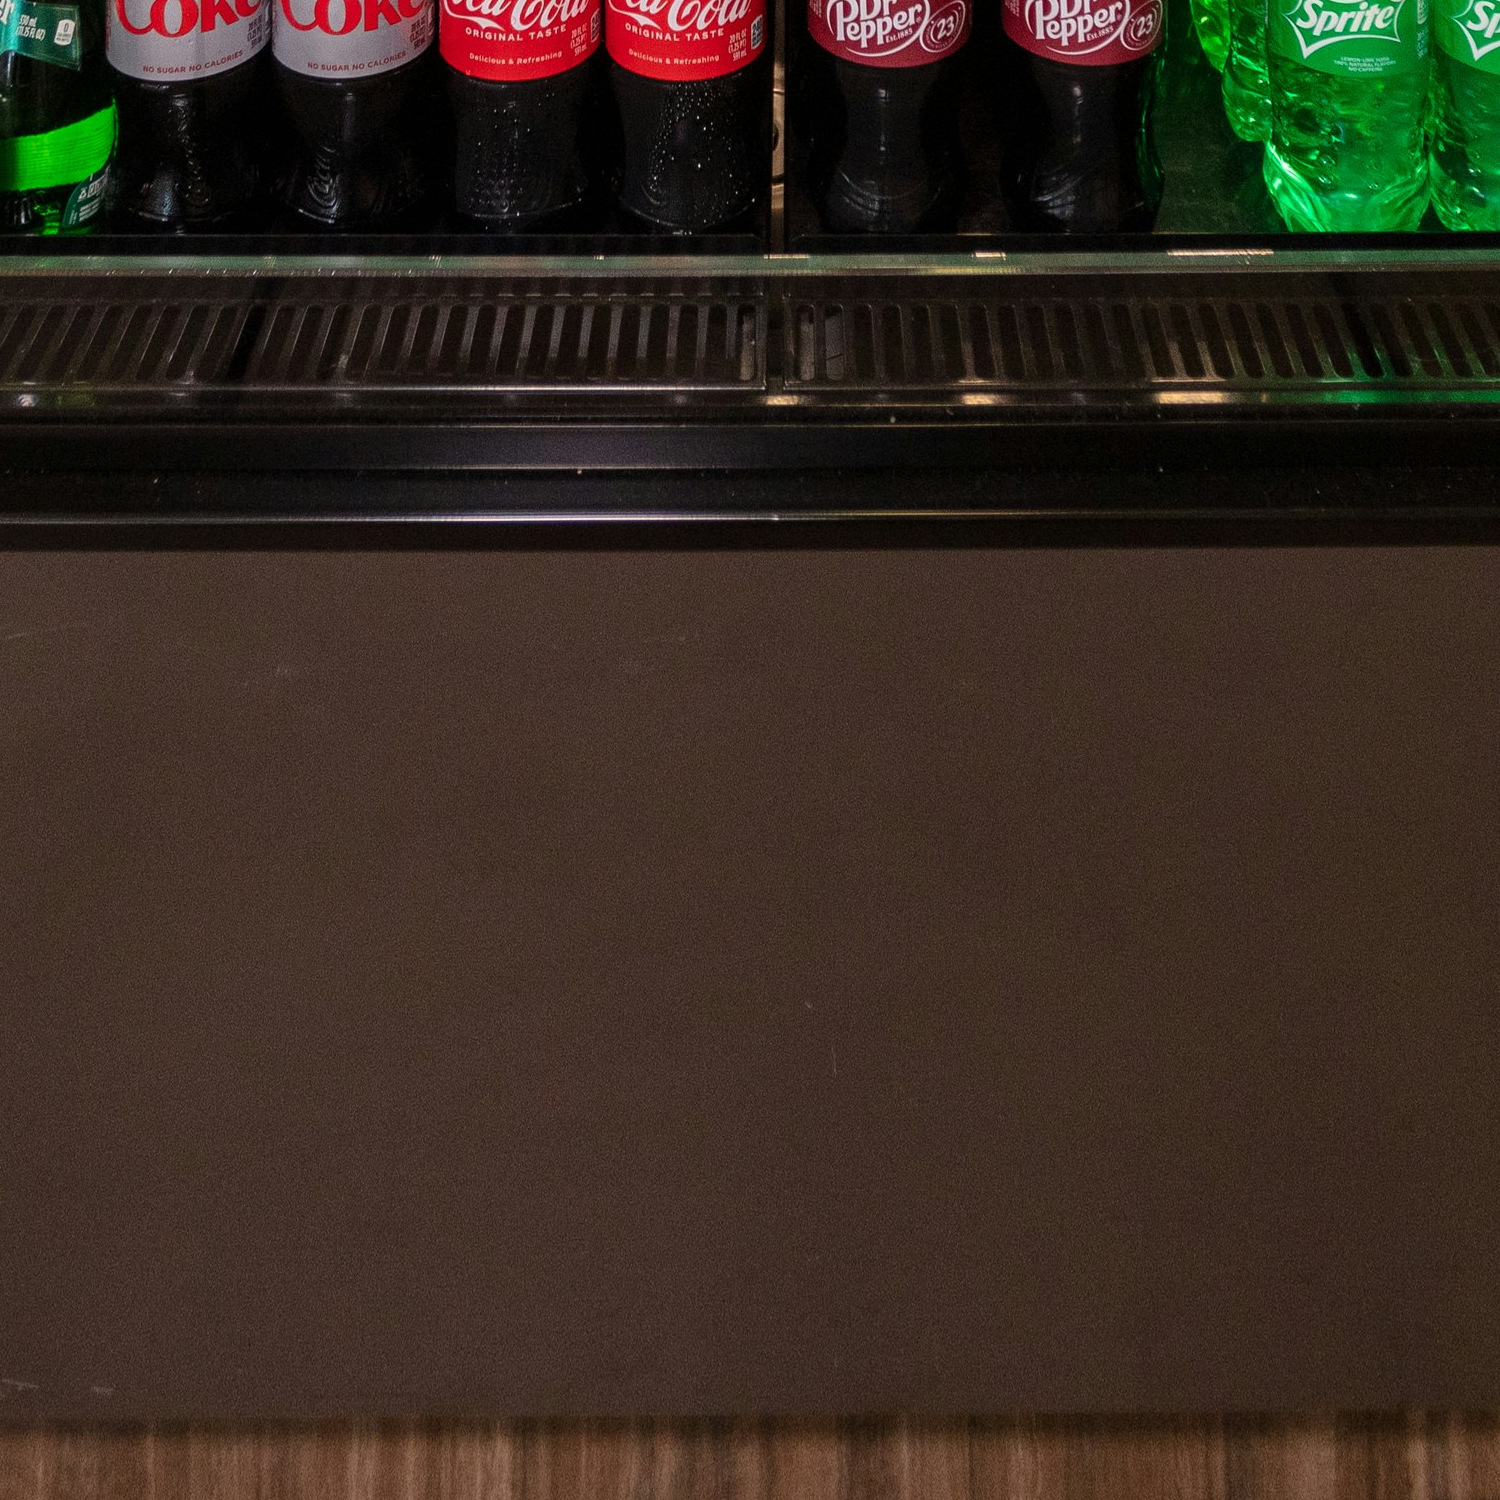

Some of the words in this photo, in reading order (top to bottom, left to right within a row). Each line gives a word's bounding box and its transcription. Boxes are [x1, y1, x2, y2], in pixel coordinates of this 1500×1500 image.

[465, 26, 524, 42] ORIGINAL
[529, 23, 567, 40] TASTE
[625, 22, 681, 42] ORIGINAL
[685, 28, 725, 41] TASTE
[936, 16, 955, 41] 23
[1136, 13, 1154, 38] 23
[156, 65, 186, 74] SUGAR
[189, 64, 202, 72] NO
[204, 50, 244, 69] CALORIES
[307, 62, 319, 70] NO
[320, 63, 350, 71] SUGAR
[352, 61, 365, 70] NO
[367, 50, 406, 68] CALORIES
[469, 52, 506, 65] Delicious
[516, 51, 563, 65] Refreshing
[628, 48, 663, 65] Delicious
[665, 57, 671, 65] &
[673, 54, 720, 65] Refreshing
